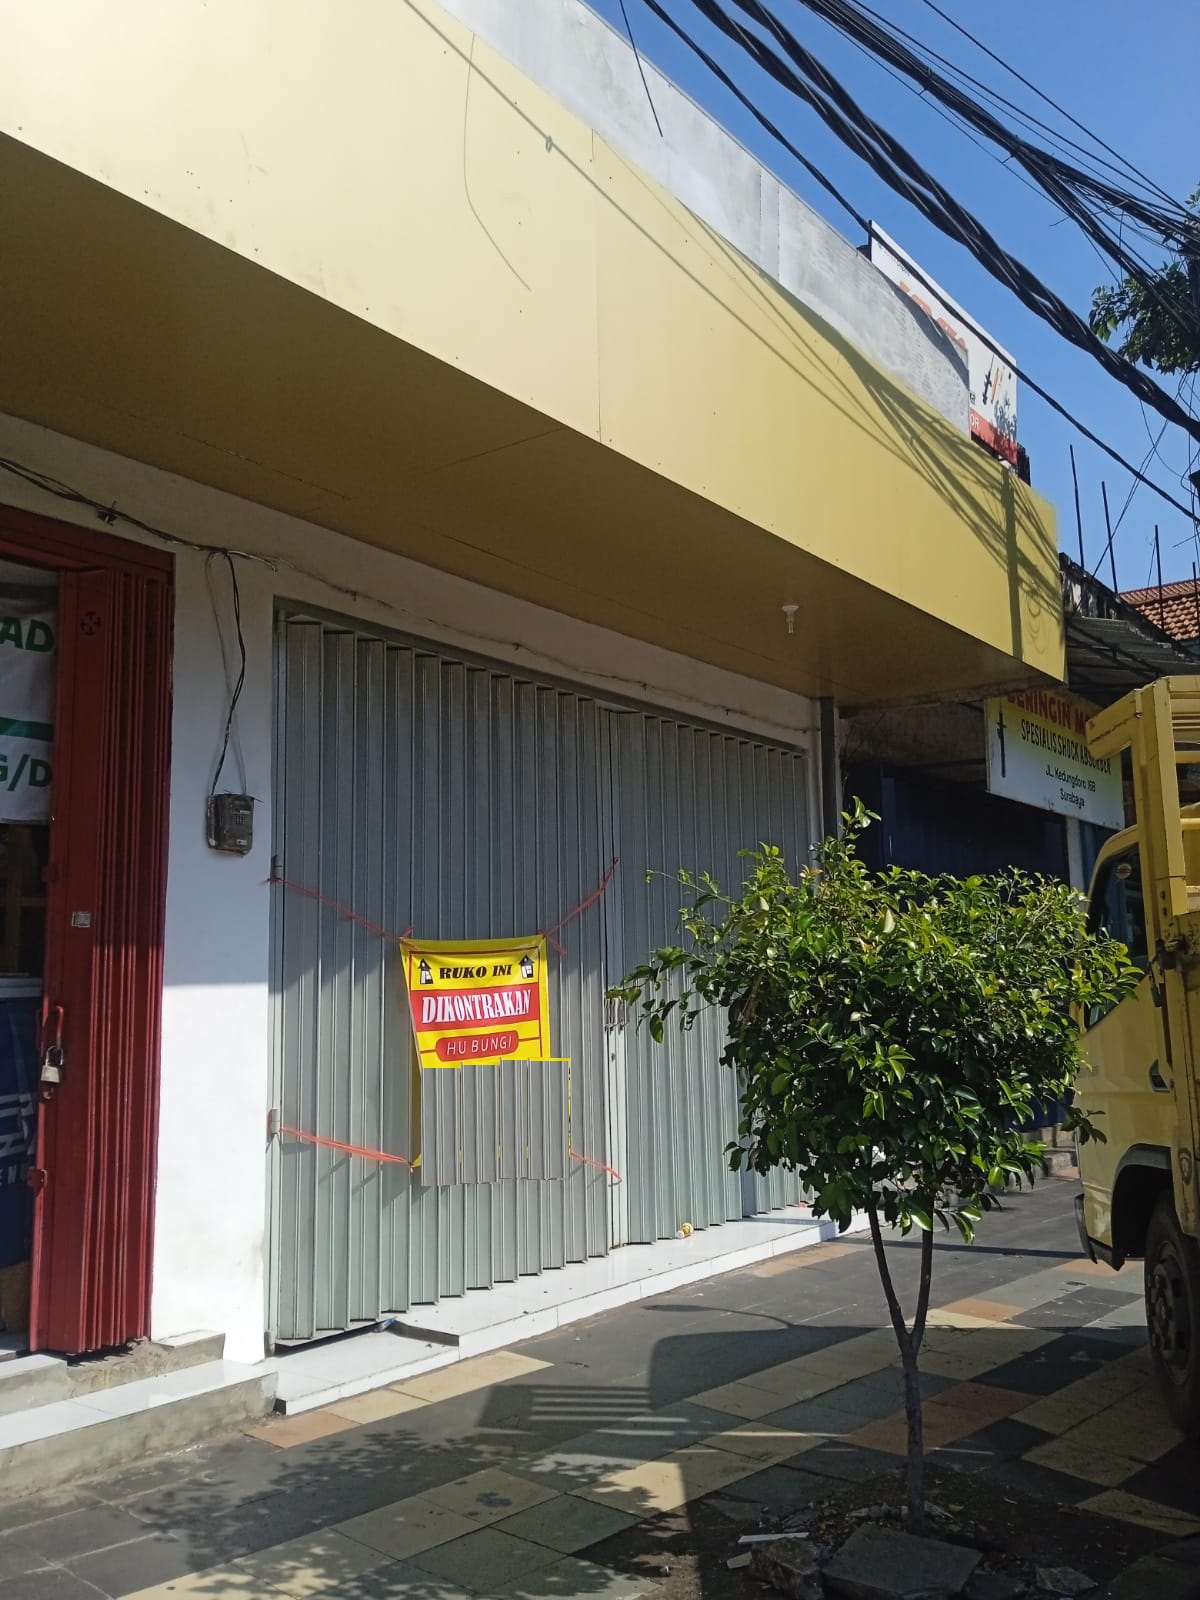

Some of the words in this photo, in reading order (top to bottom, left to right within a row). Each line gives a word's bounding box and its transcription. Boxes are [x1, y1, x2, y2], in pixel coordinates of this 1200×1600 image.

[1021, 719, 1057, 753] SPESIALIS
[1058, 735, 1079, 761] SHOCK
[1060, 788, 1085, 809] Surabaya
[439, 965, 487, 979] RUKO
[493, 964, 512, 977] INI
[422, 989, 531, 1024] DIKONTRAKAN
